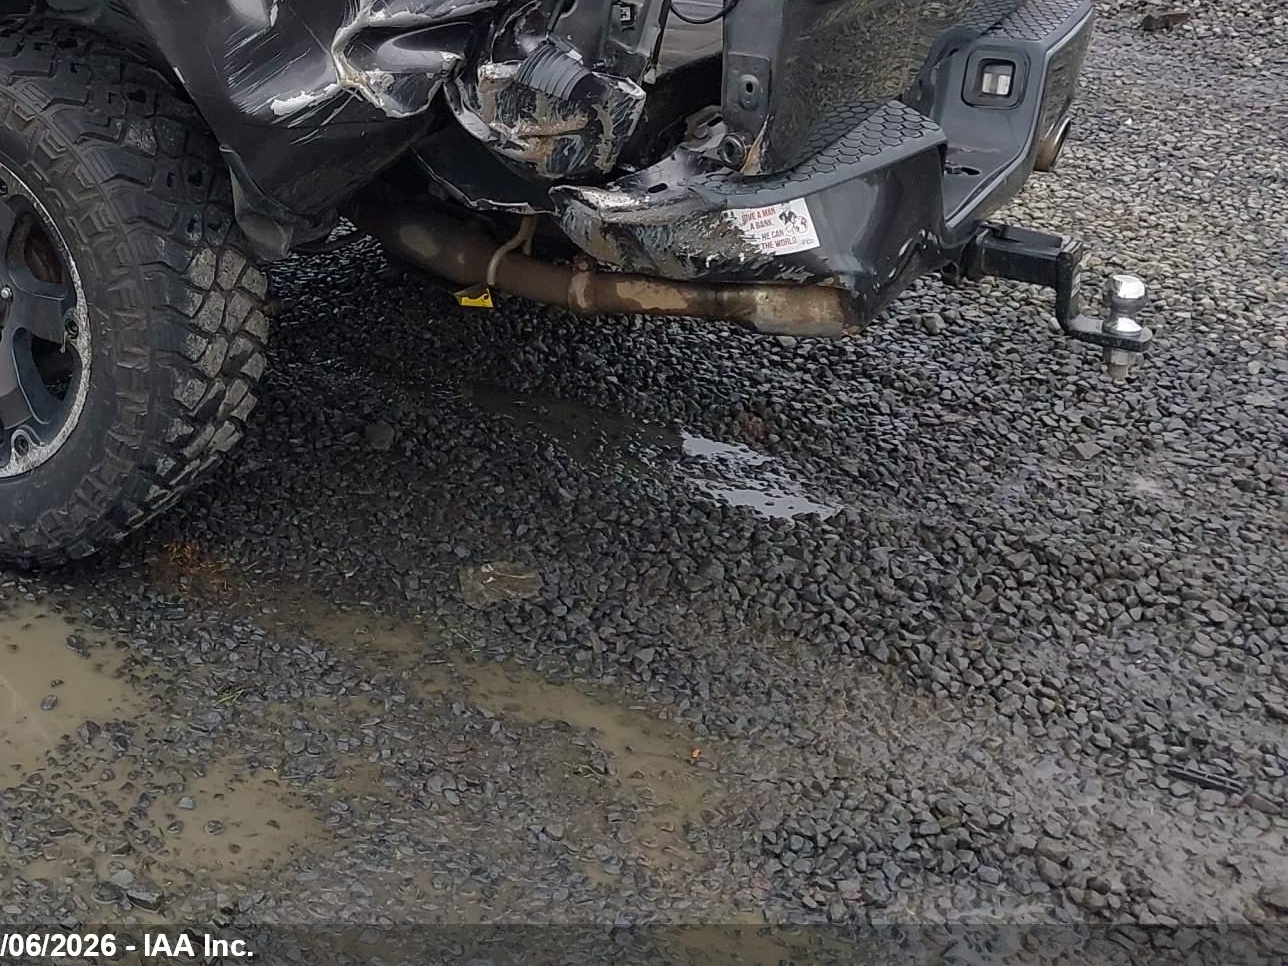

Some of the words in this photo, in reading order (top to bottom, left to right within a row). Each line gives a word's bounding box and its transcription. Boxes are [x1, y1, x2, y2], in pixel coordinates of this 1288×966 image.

[762, 207, 776, 217] MAN
[762, 232, 771, 240] HE
[772, 229, 784, 238] CAN
[761, 241, 774, 250] THE
[775, 236, 797, 247] WORLD
